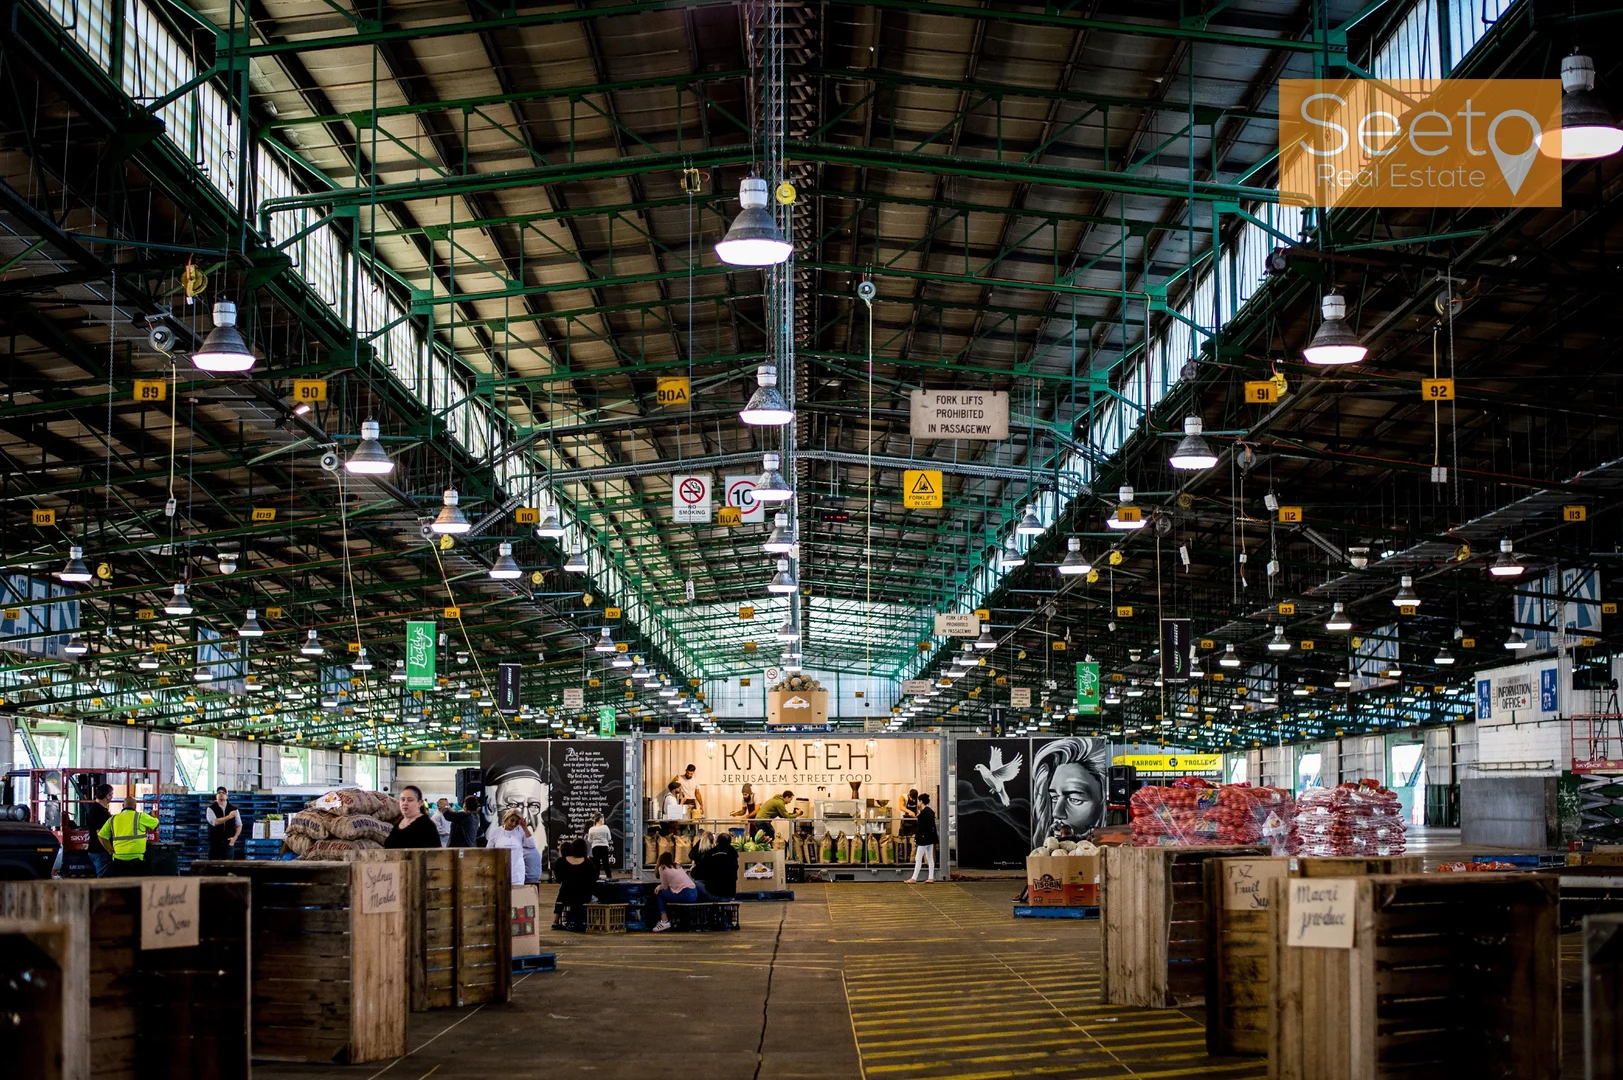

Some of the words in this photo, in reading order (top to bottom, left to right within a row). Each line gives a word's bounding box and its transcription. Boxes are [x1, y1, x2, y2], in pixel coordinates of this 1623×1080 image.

[142, 387, 158, 398] 89
[302, 387, 318, 398] 90
[658, 388, 686, 401] 90A
[1257, 388, 1269, 400] 91
[1430, 386, 1447, 397] 92
[936, 395, 957, 404] FORK
[961, 396, 984, 405] LIFTS
[936, 409, 984, 418] PROHIBITED
[928, 424, 936, 432] IN
[940, 424, 992, 434] PASSAGEWAY
[732, 488, 756, 505] 10
[36, 514, 50, 523] 108
[522, 513, 533, 521] 110
[720, 514, 740, 523] 110A
[1285, 512, 1296, 520] 112
[1570, 511, 1580, 519] 113
[1498, 683, 1531, 698] INFORMATION
[1502, 697, 1521, 710] OFFICE
[722, 744, 869, 770] KNAFEH
[722, 774, 788, 782] JERUSALEM
[793, 774, 834, 782] STREET
[840, 774, 872, 782] FOOD
[366, 867, 393, 888] Sydney
[1234, 880, 1260, 895] Fruit
[1298, 906, 1346, 940] produce
